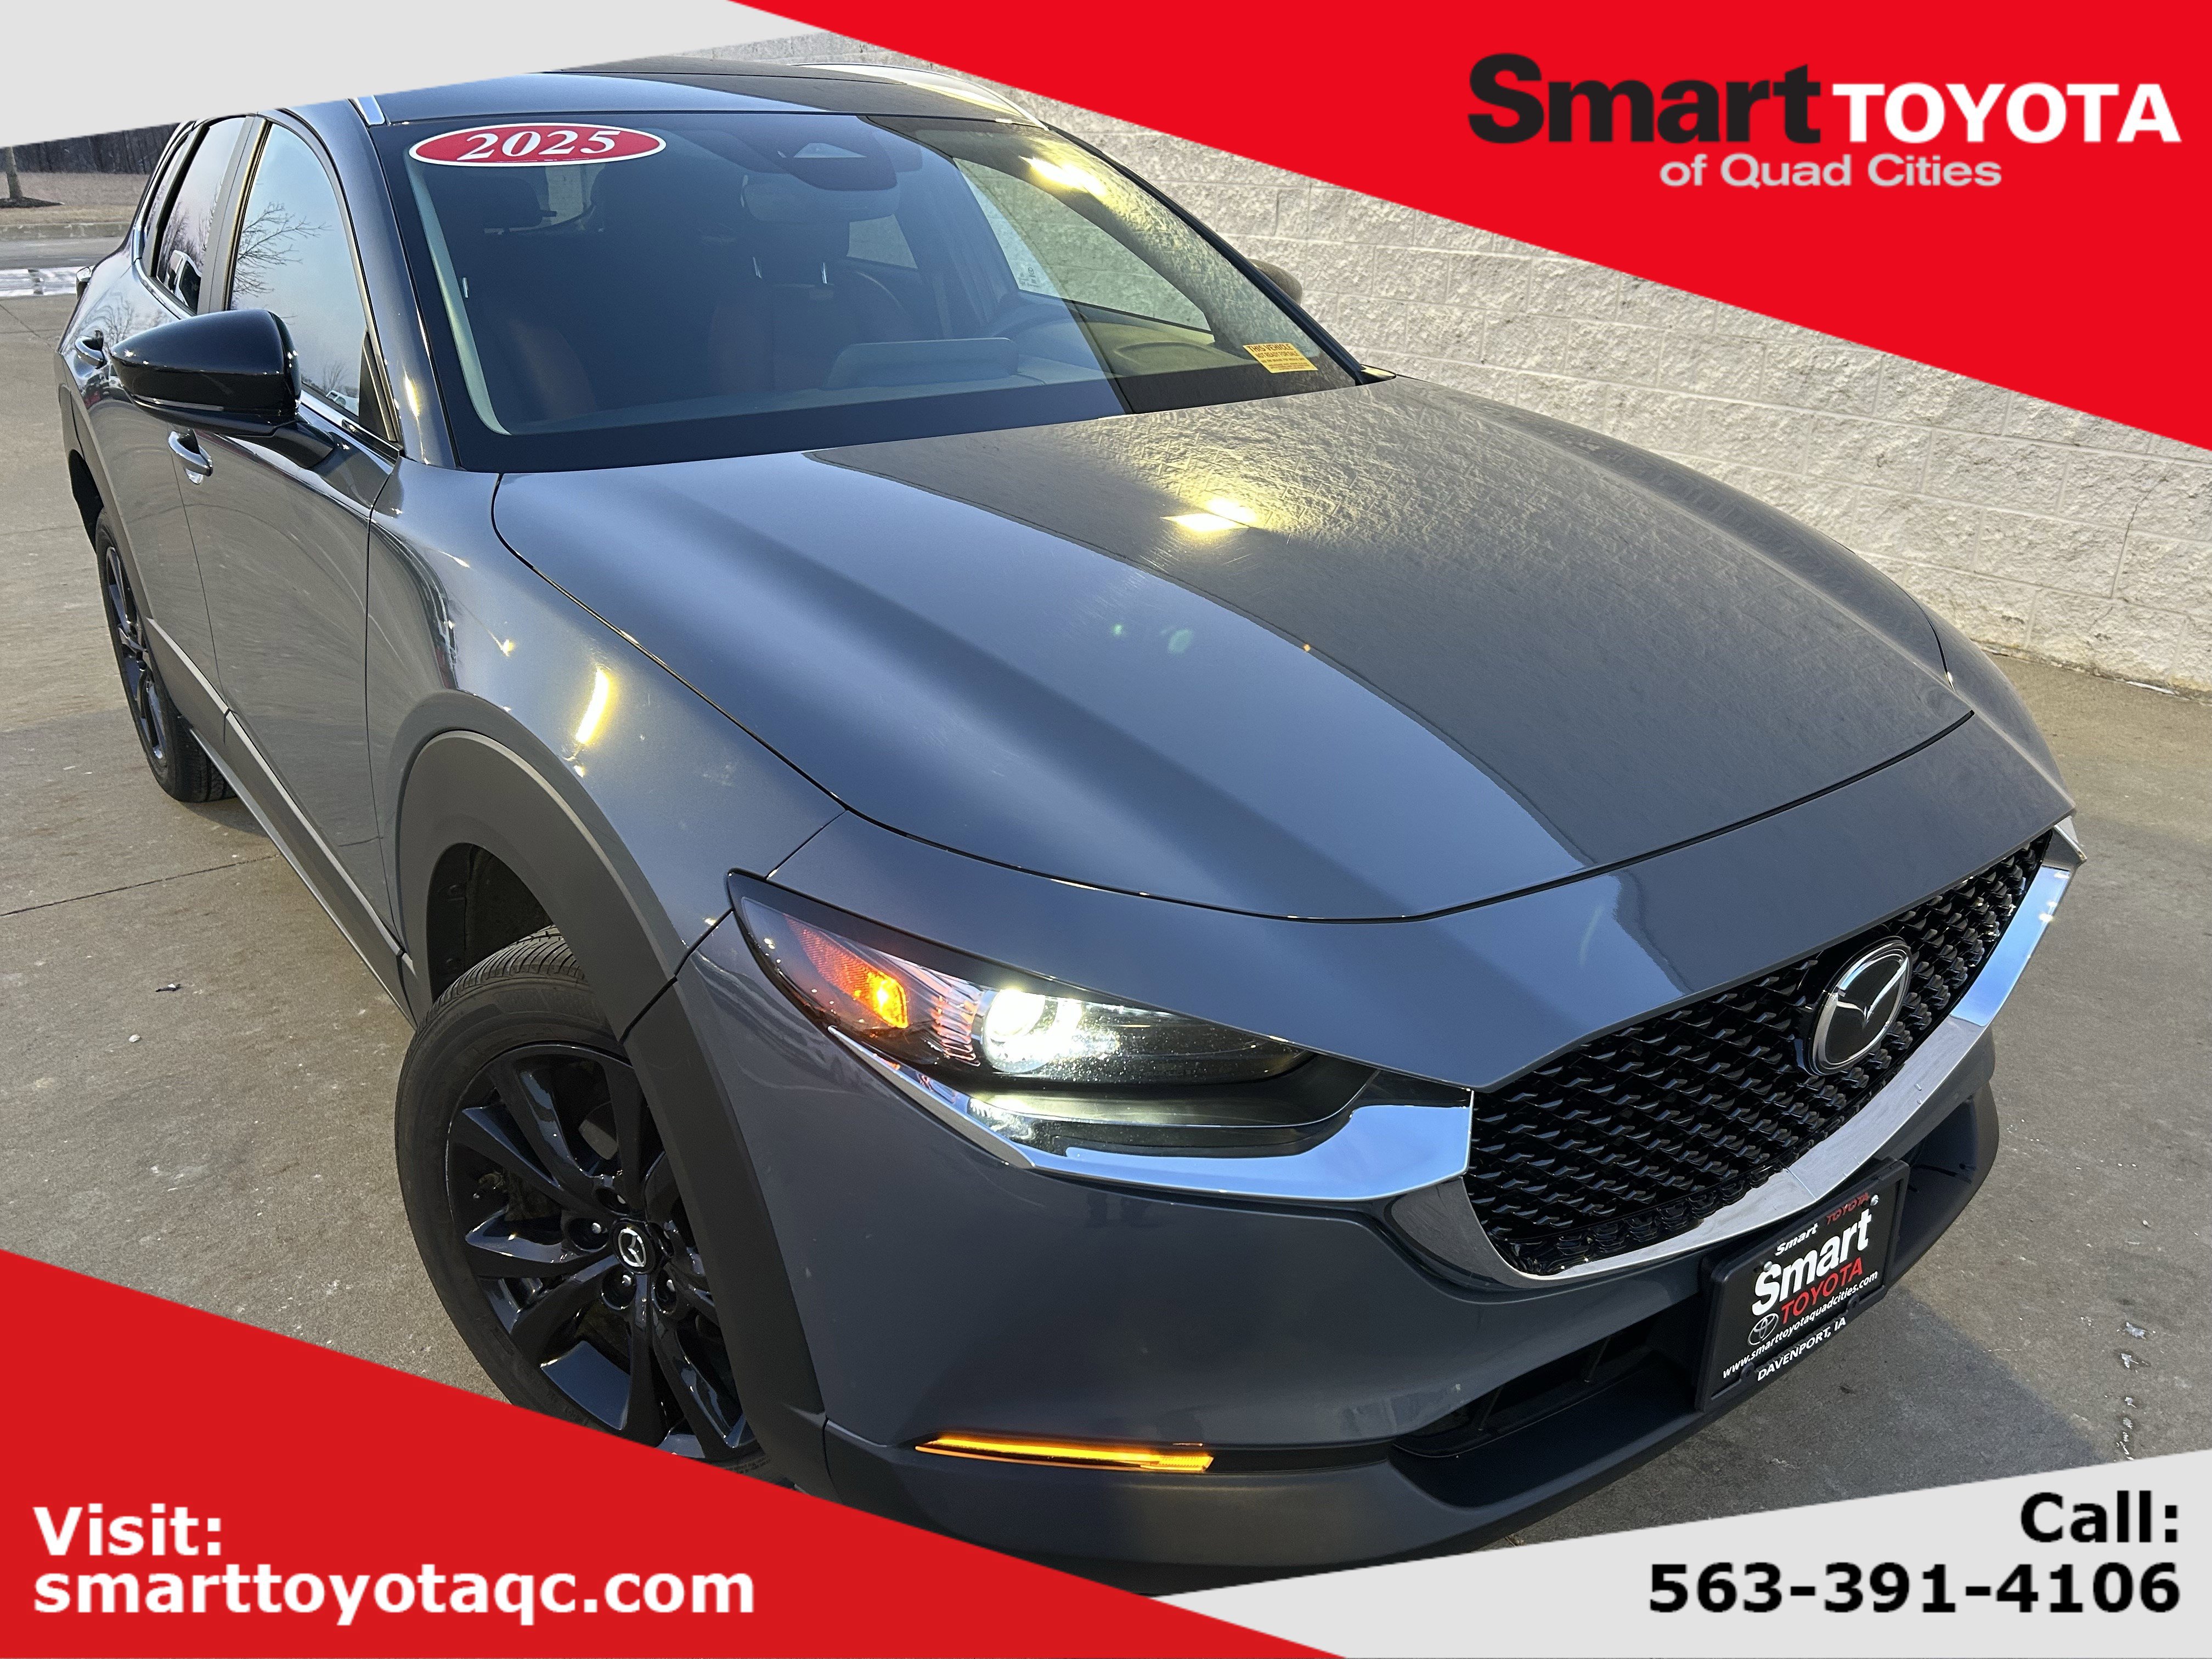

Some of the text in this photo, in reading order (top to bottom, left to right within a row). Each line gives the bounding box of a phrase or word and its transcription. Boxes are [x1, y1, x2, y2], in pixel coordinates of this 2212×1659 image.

[456, 130, 621, 161] 2025
[1246, 345, 1266, 353] THIS
[1775, 1192, 1870, 1256] Smart TOYOTA
[1752, 1209, 1872, 1316] Smart
[1781, 1257, 1863, 1324] TOYOTA
[1723, 1271, 1878, 1379] www.smarttoyotaquadcities.com
[1757, 1317, 1846, 1381] DAVENPORT, IA
